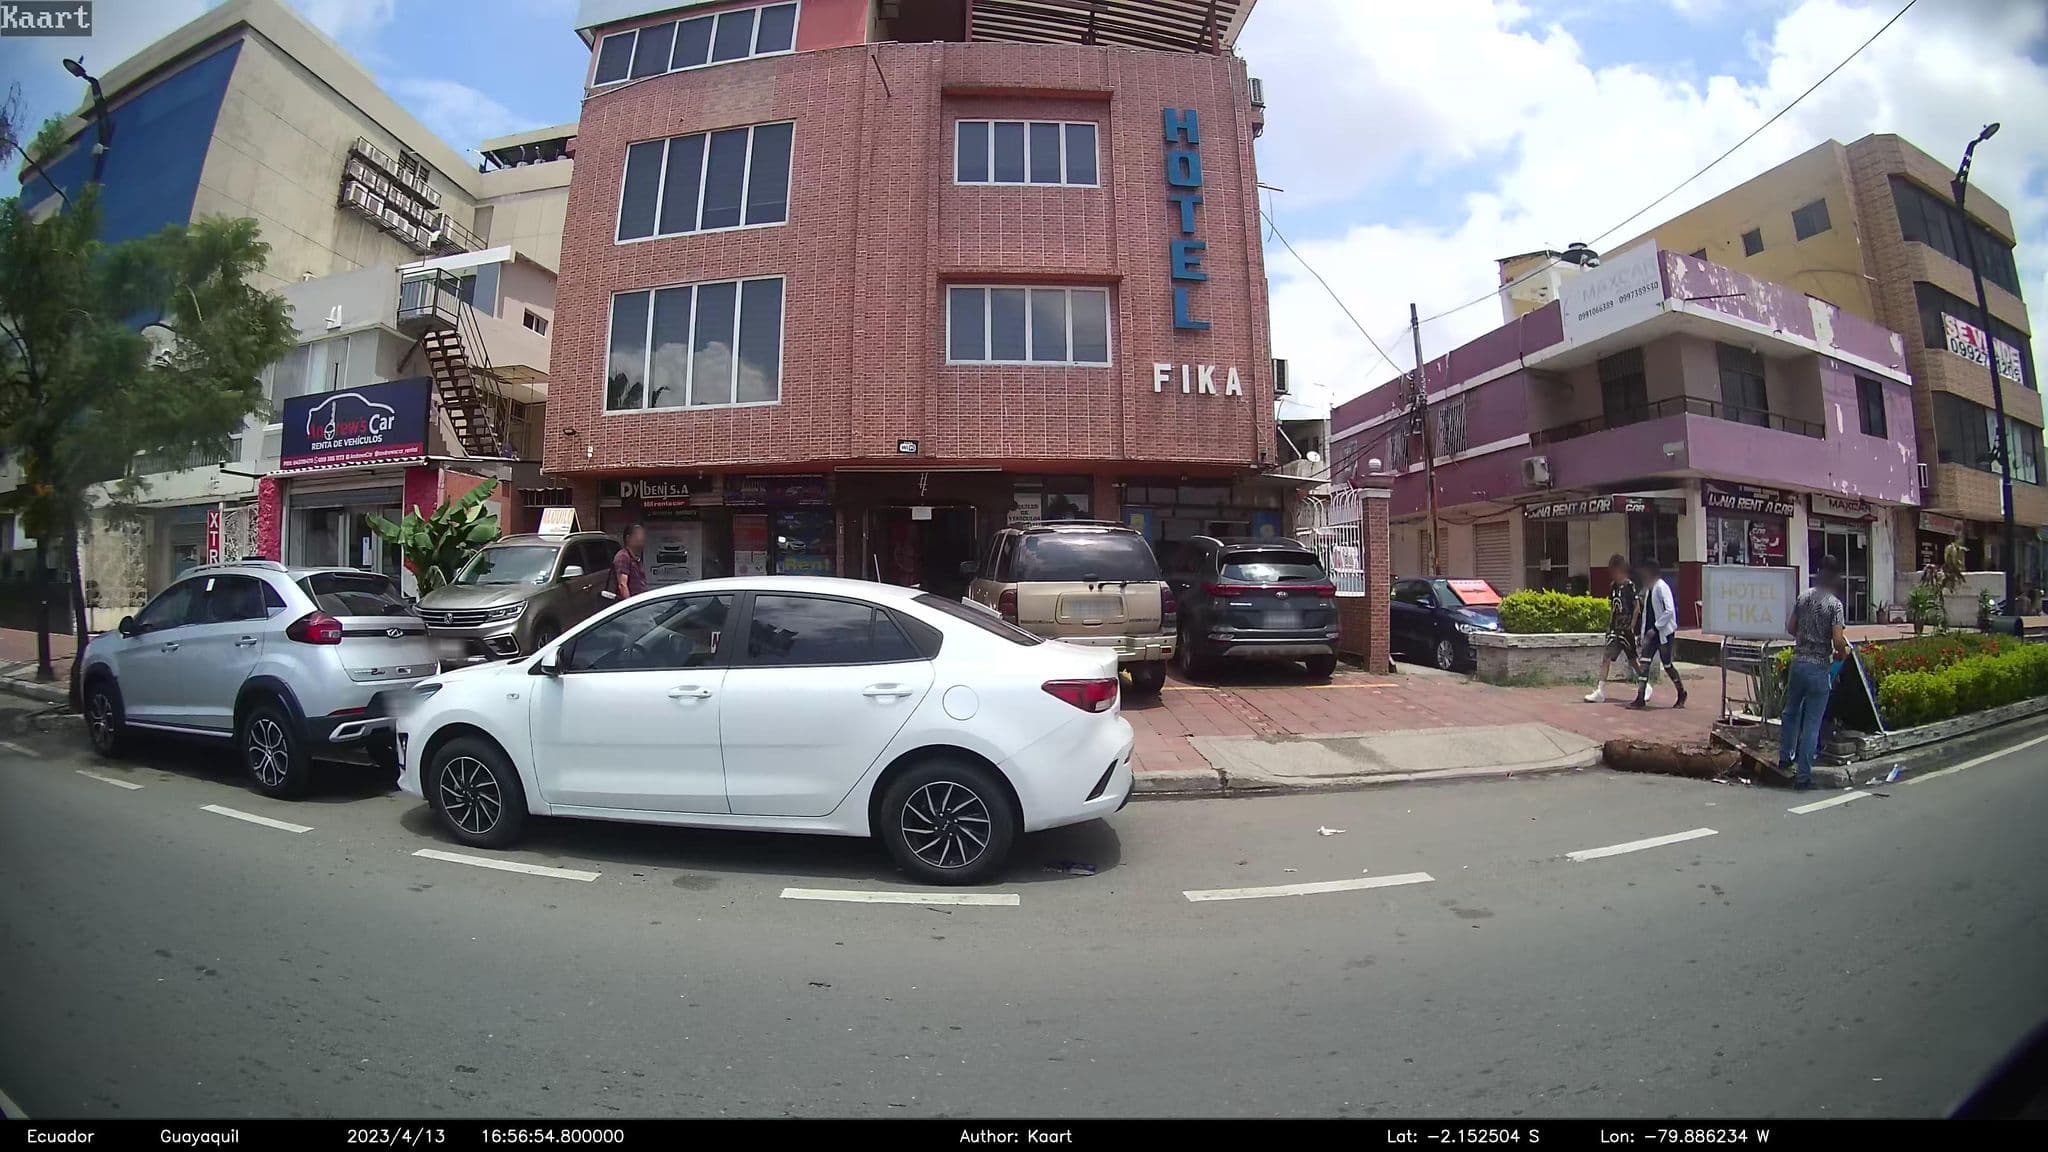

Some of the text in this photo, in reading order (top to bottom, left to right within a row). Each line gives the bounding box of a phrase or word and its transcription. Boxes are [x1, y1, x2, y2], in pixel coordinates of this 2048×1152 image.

[1164, 107, 1211, 331] HOTEL
[1944, 315, 1969, 342] SE
[1153, 363, 1243, 397] FIKA
[369, 413, 395, 434] Car
[311, 434, 383, 450] RENTA DE VEHÍCULOS
[1552, 503, 1578, 516] RENT
[1589, 499, 1611, 513] CAR
[1625, 503, 1646, 513] CAR
[1737, 497, 1764, 511] RENT
[1765, 501, 1773, 513] A
[1774, 503, 1794, 516] CAR
[1721, 582, 1777, 600] HOTEL
[1727, 604, 1773, 624] FIKA
